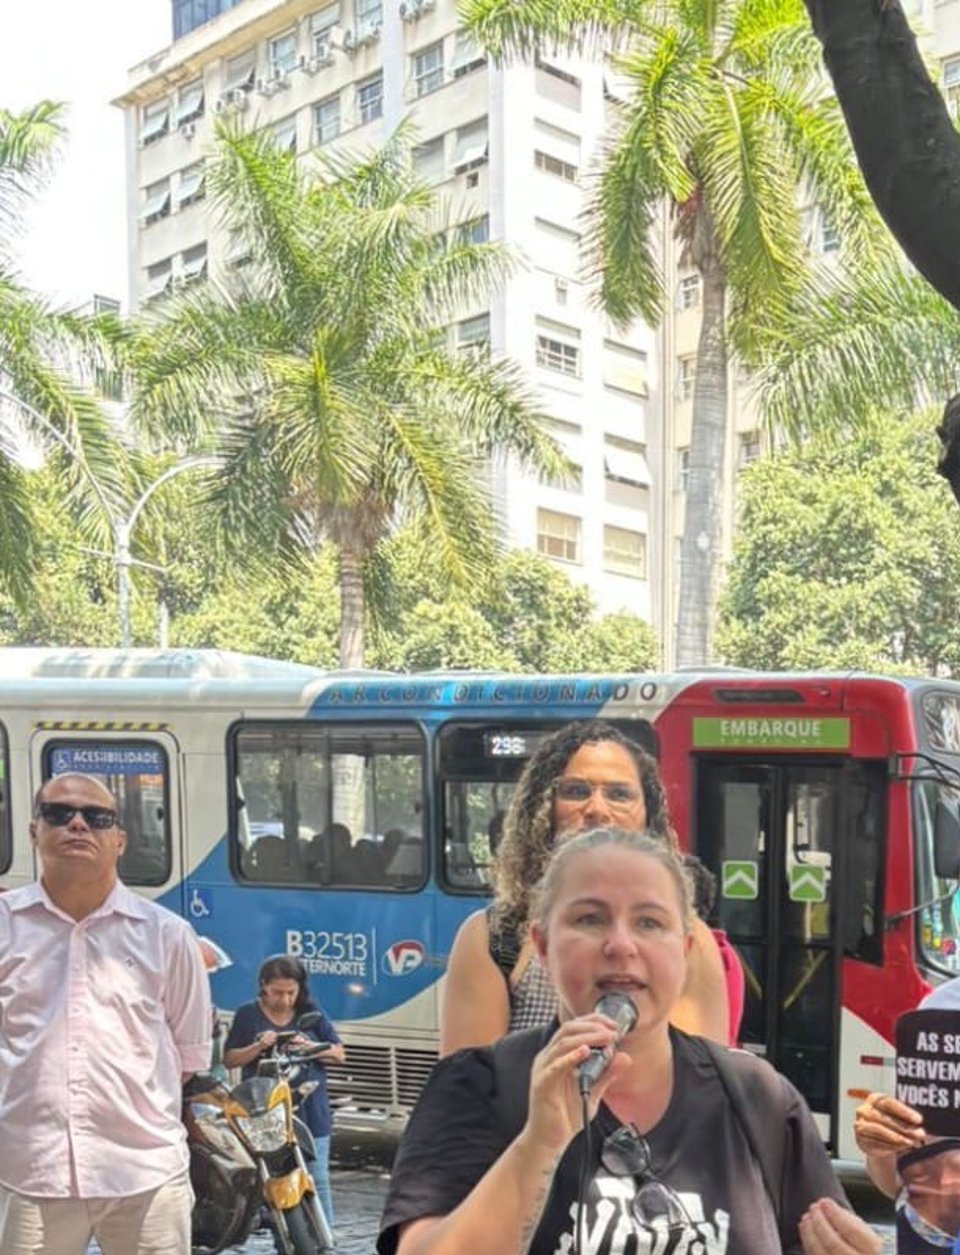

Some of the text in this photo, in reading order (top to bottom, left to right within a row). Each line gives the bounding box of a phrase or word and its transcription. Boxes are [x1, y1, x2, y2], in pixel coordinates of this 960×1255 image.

[720, 719, 821, 738] EMBARQUE
[286, 930, 367, 961] B32513
[299, 959, 366, 976] TERNORTE
[917, 1032, 939, 1052] AS
[898, 1084, 949, 1108] VOCÊS
